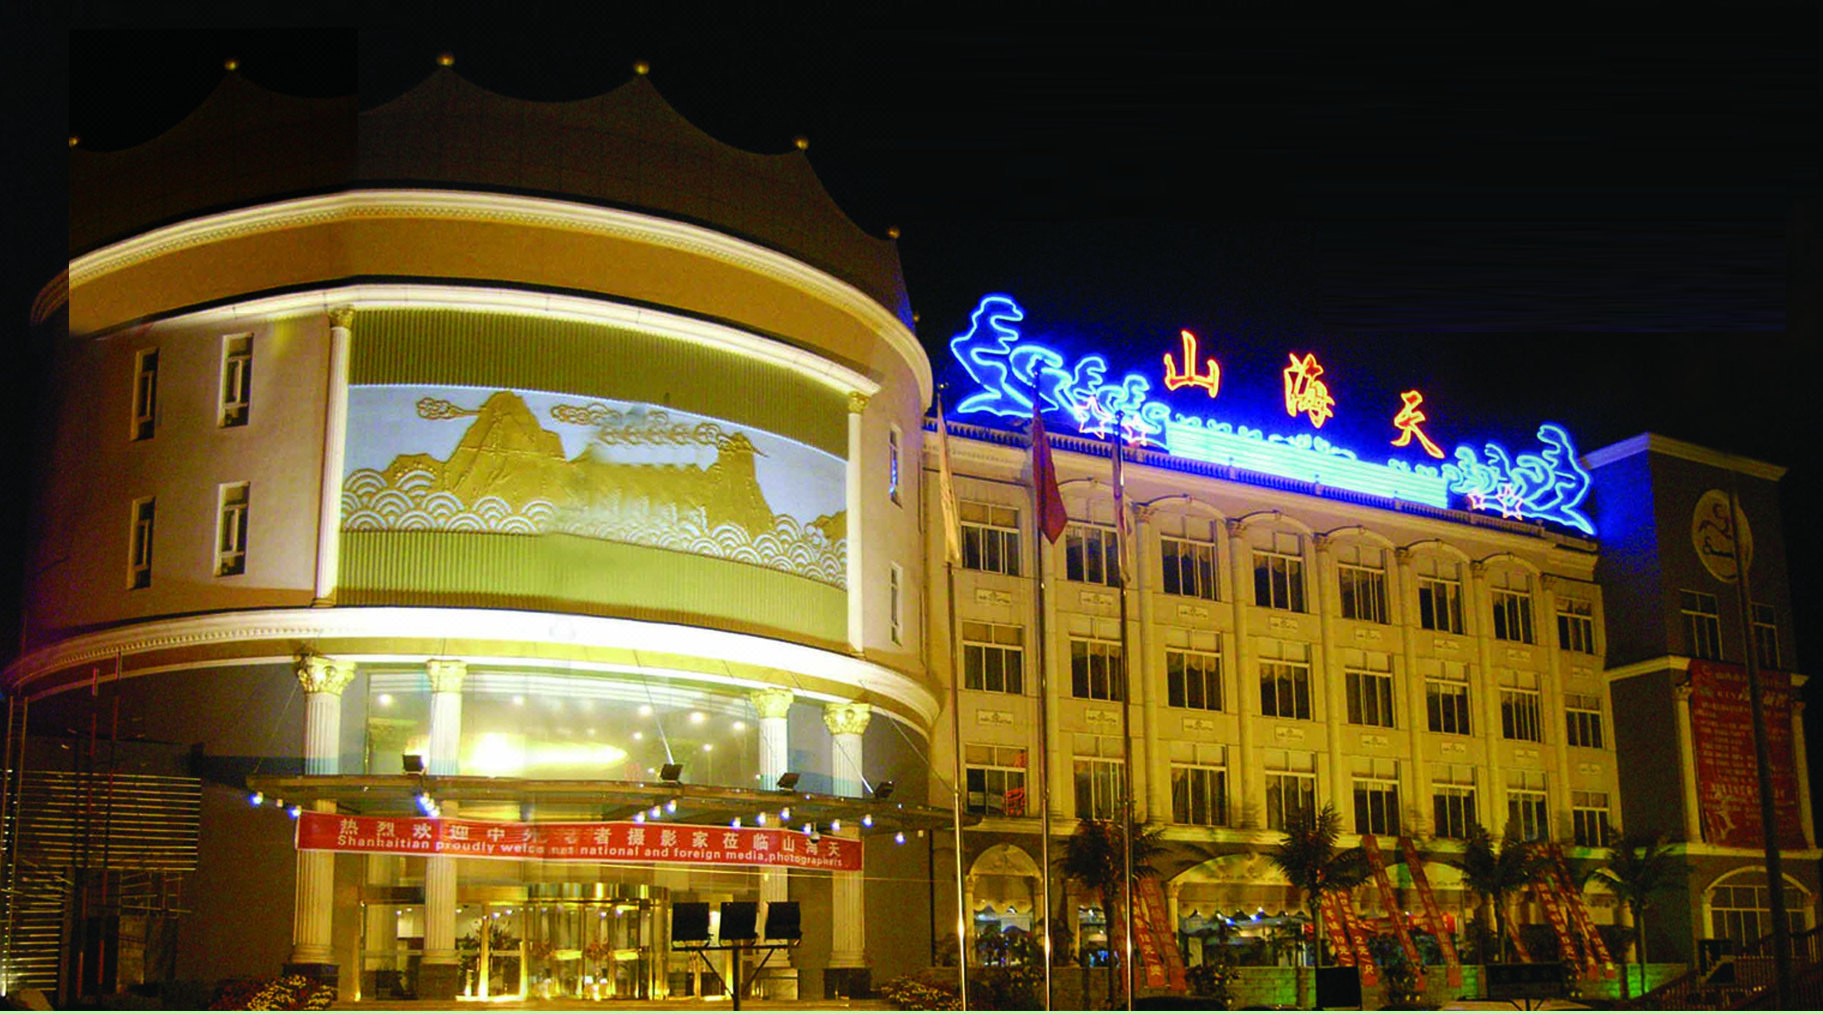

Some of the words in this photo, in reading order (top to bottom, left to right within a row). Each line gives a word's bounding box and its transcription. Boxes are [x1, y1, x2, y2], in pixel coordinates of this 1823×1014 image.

[1162, 328, 1446, 460] 山海天
[337, 835, 430, 850] Shanhaitian
[435, 841, 494, 855] proudly
[580, 845, 639, 857] national
[644, 847, 669, 859] and
[674, 847, 722, 861] foreign
